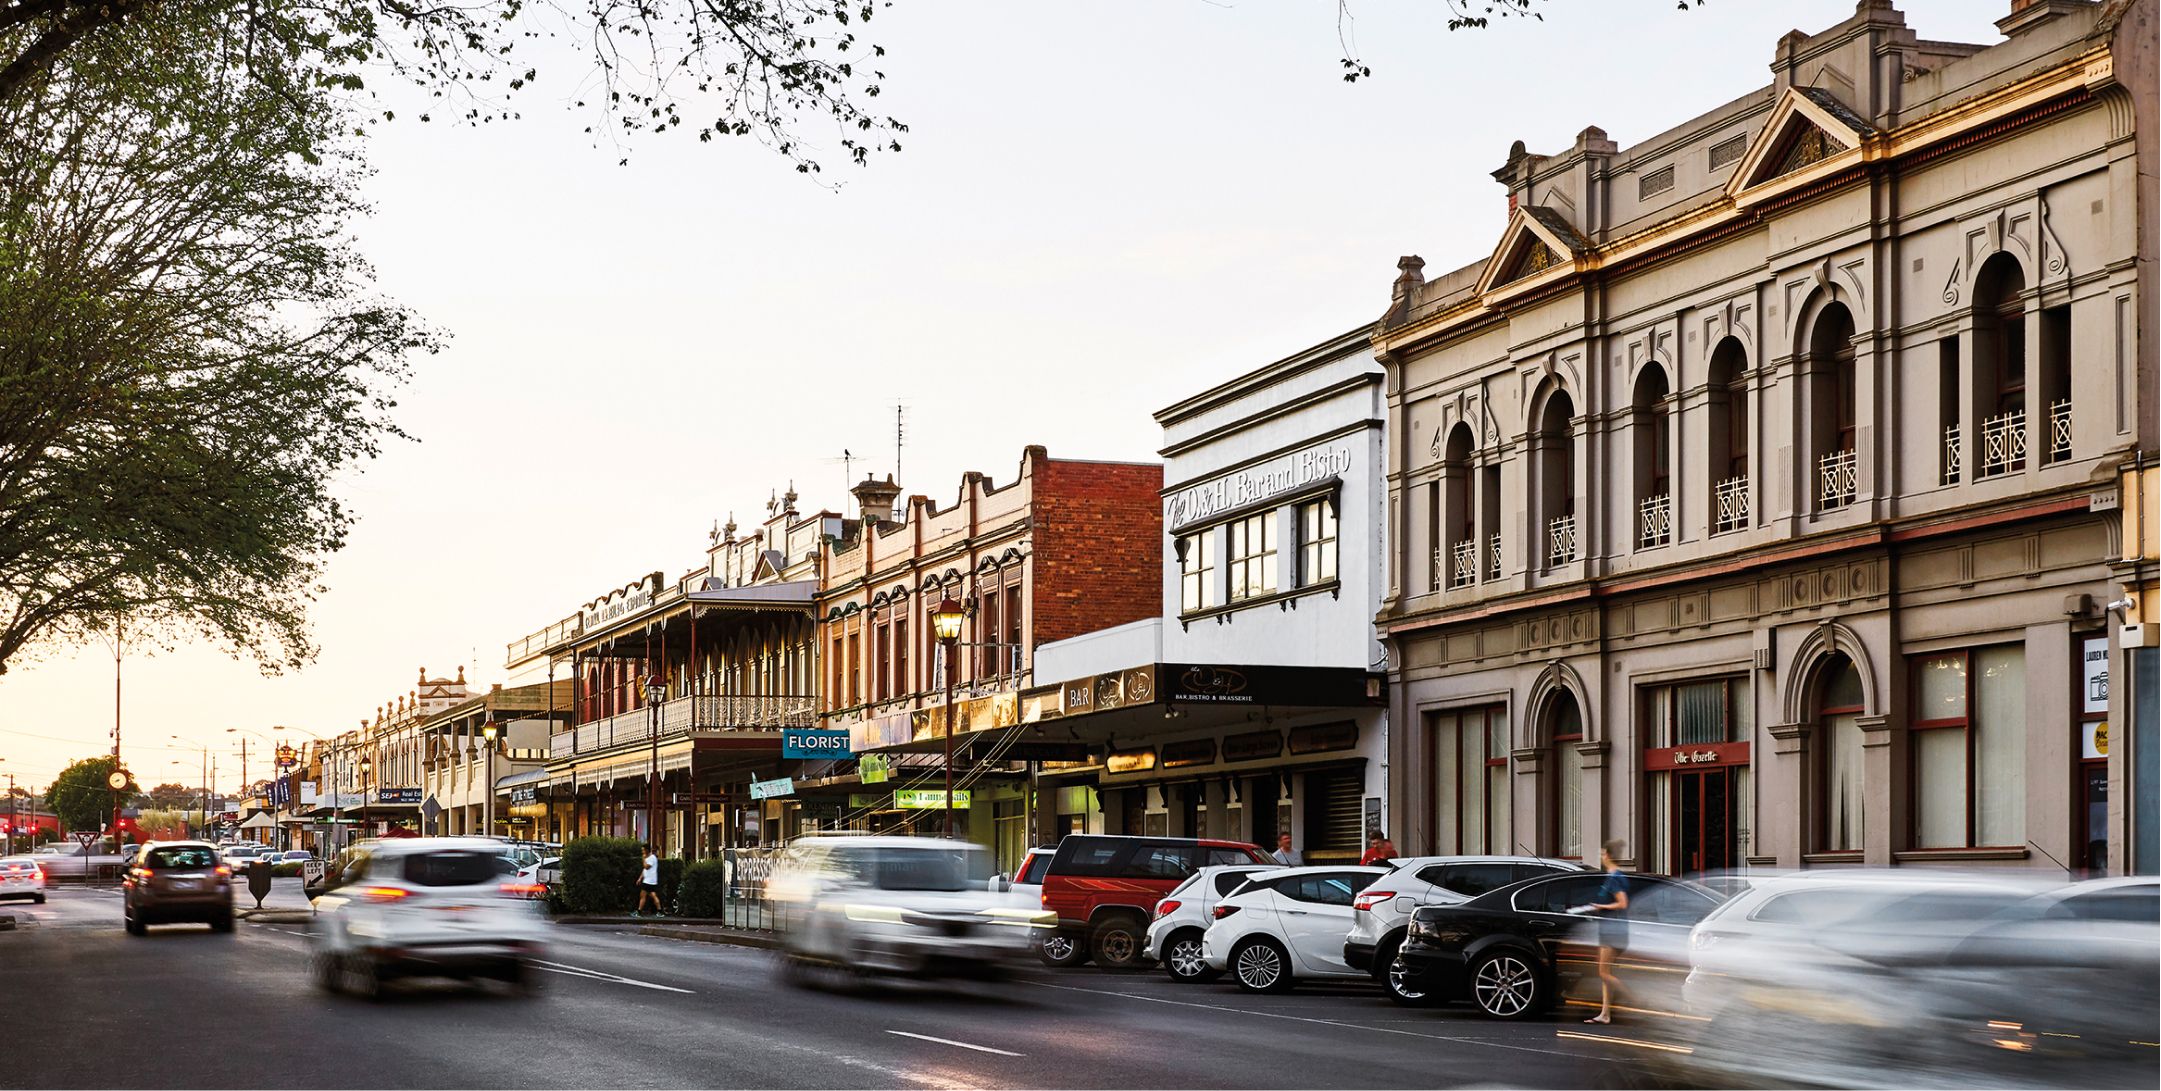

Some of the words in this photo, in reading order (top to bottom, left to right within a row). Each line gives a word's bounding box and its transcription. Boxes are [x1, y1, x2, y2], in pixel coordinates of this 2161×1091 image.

[1299, 446, 1351, 487] Bistro
[1070, 687, 1089, 707] BAR
[788, 735, 849, 749] FLORIST
[1674, 752, 1689, 764] The
[1691, 750, 1718, 763] Gazette
